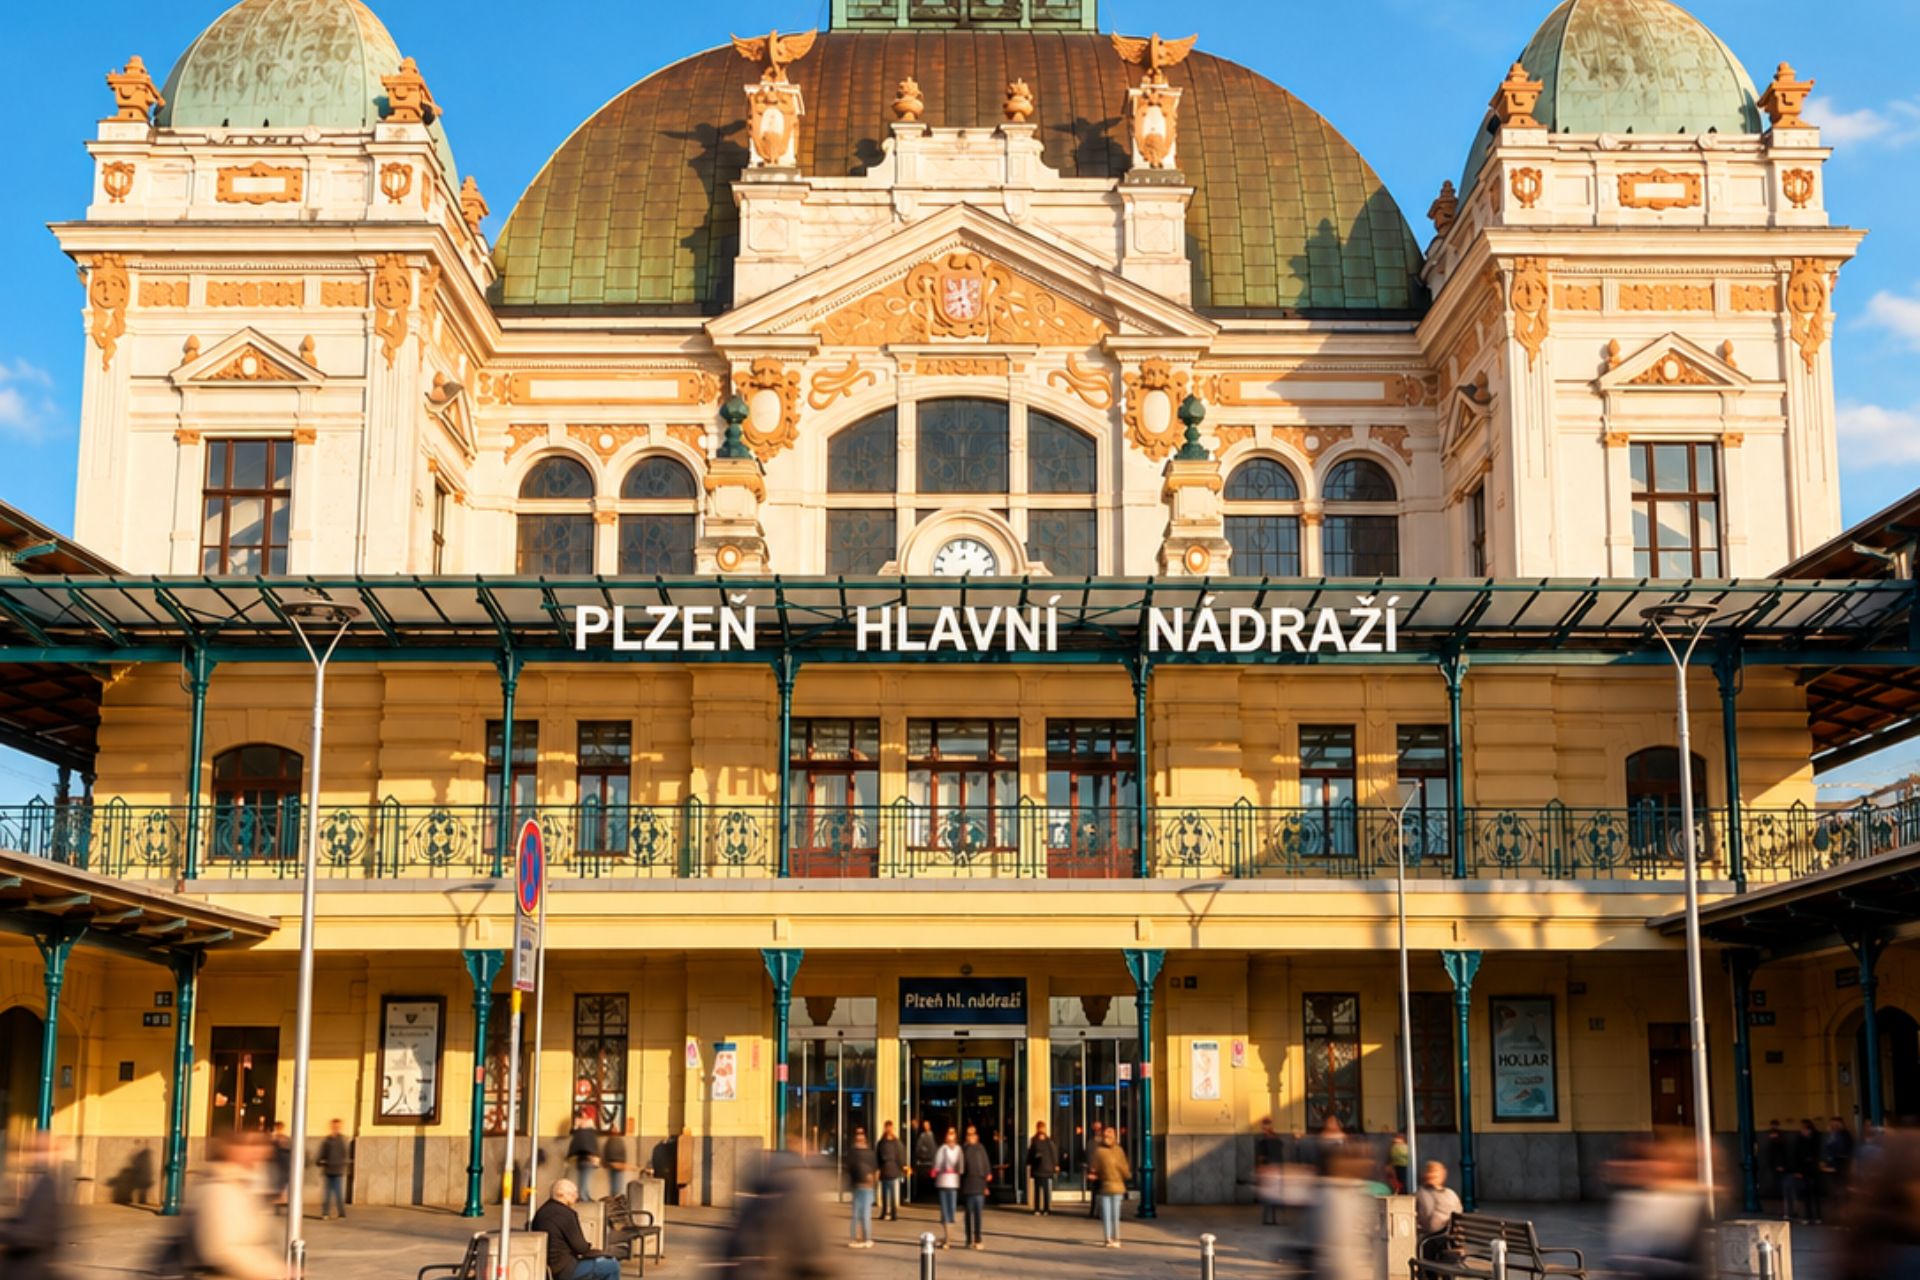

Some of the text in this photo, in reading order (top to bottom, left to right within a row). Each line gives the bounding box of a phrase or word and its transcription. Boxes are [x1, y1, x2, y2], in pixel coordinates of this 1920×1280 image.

[575, 593, 1400, 652] PLZEŇ HLAVNÍ NÁDRAŽÍ
[947, 992, 965, 1008] hl.
